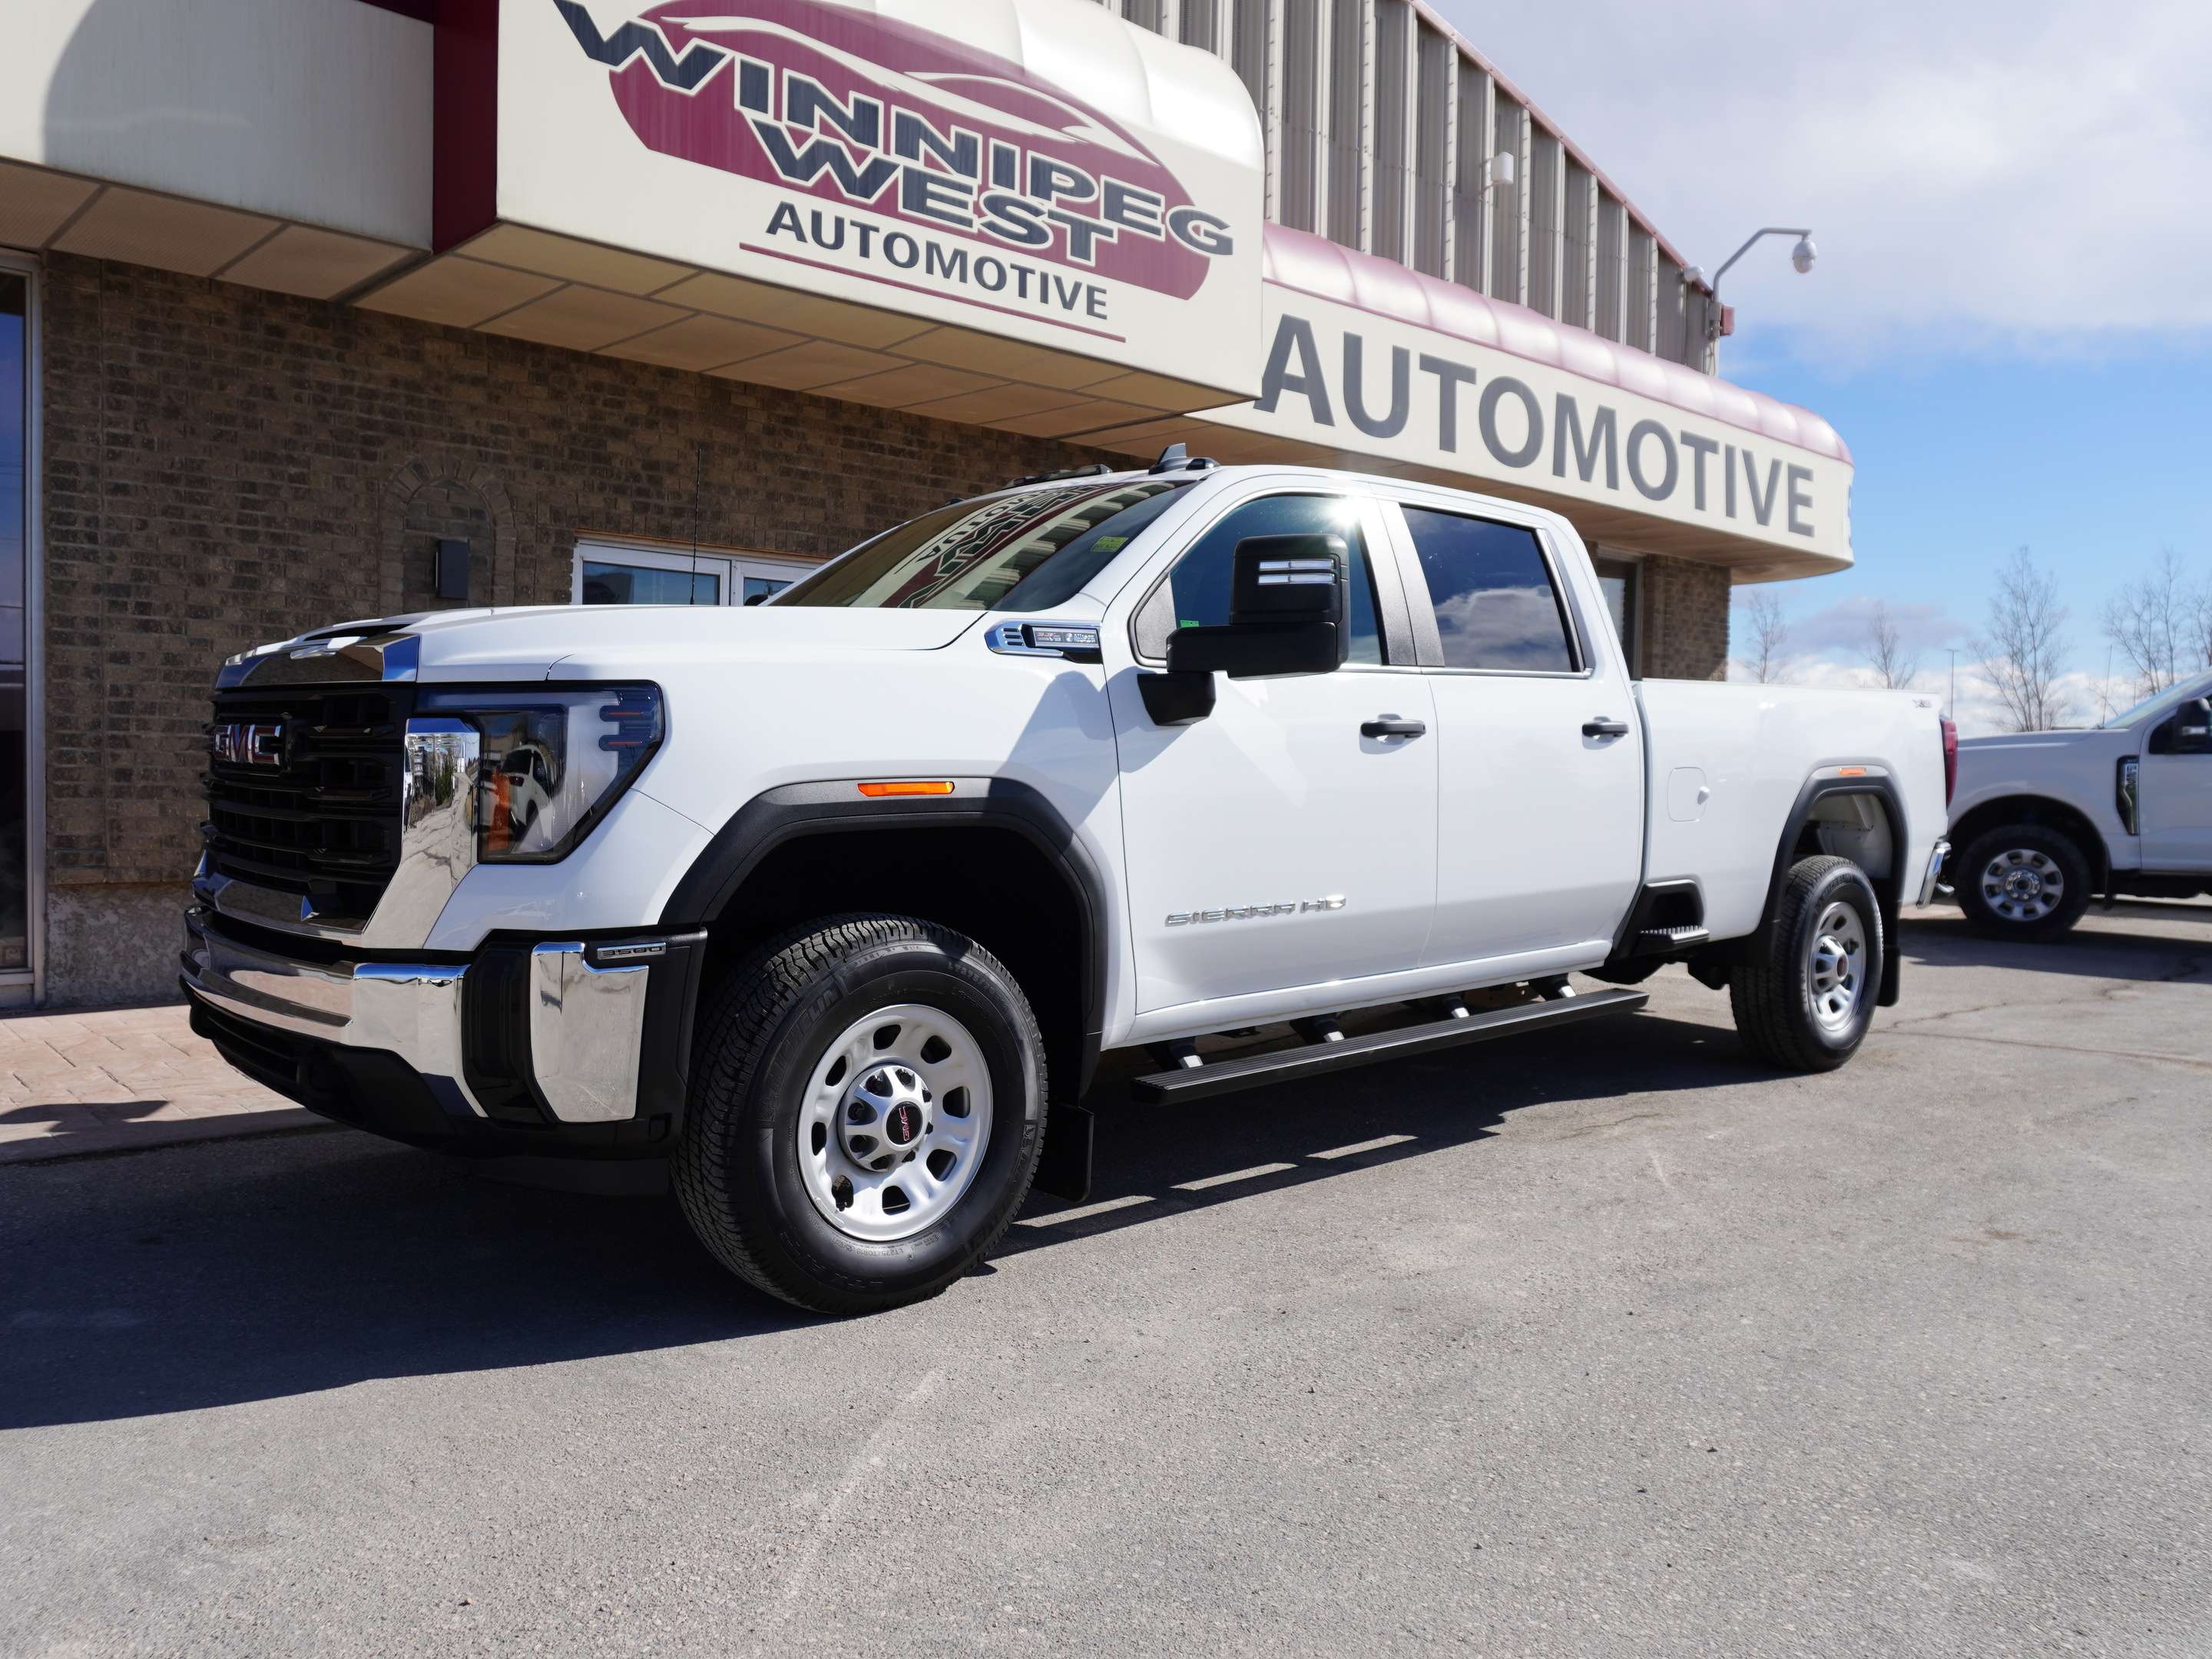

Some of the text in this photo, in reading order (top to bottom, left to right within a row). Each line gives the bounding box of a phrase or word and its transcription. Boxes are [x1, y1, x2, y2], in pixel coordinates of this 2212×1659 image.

[552, 0, 1234, 256] WINNIPEG
[751, 118, 1118, 266] WEST
[765, 200, 1108, 320] AUTOMOTIVE
[1253, 313, 1815, 538] AUTOMOTIVE
[214, 724, 282, 766] GMC
[1165, 894, 1346, 926] SIERRA HD
[600, 945, 664, 958] 3500
[898, 1105, 911, 1142] GMC
